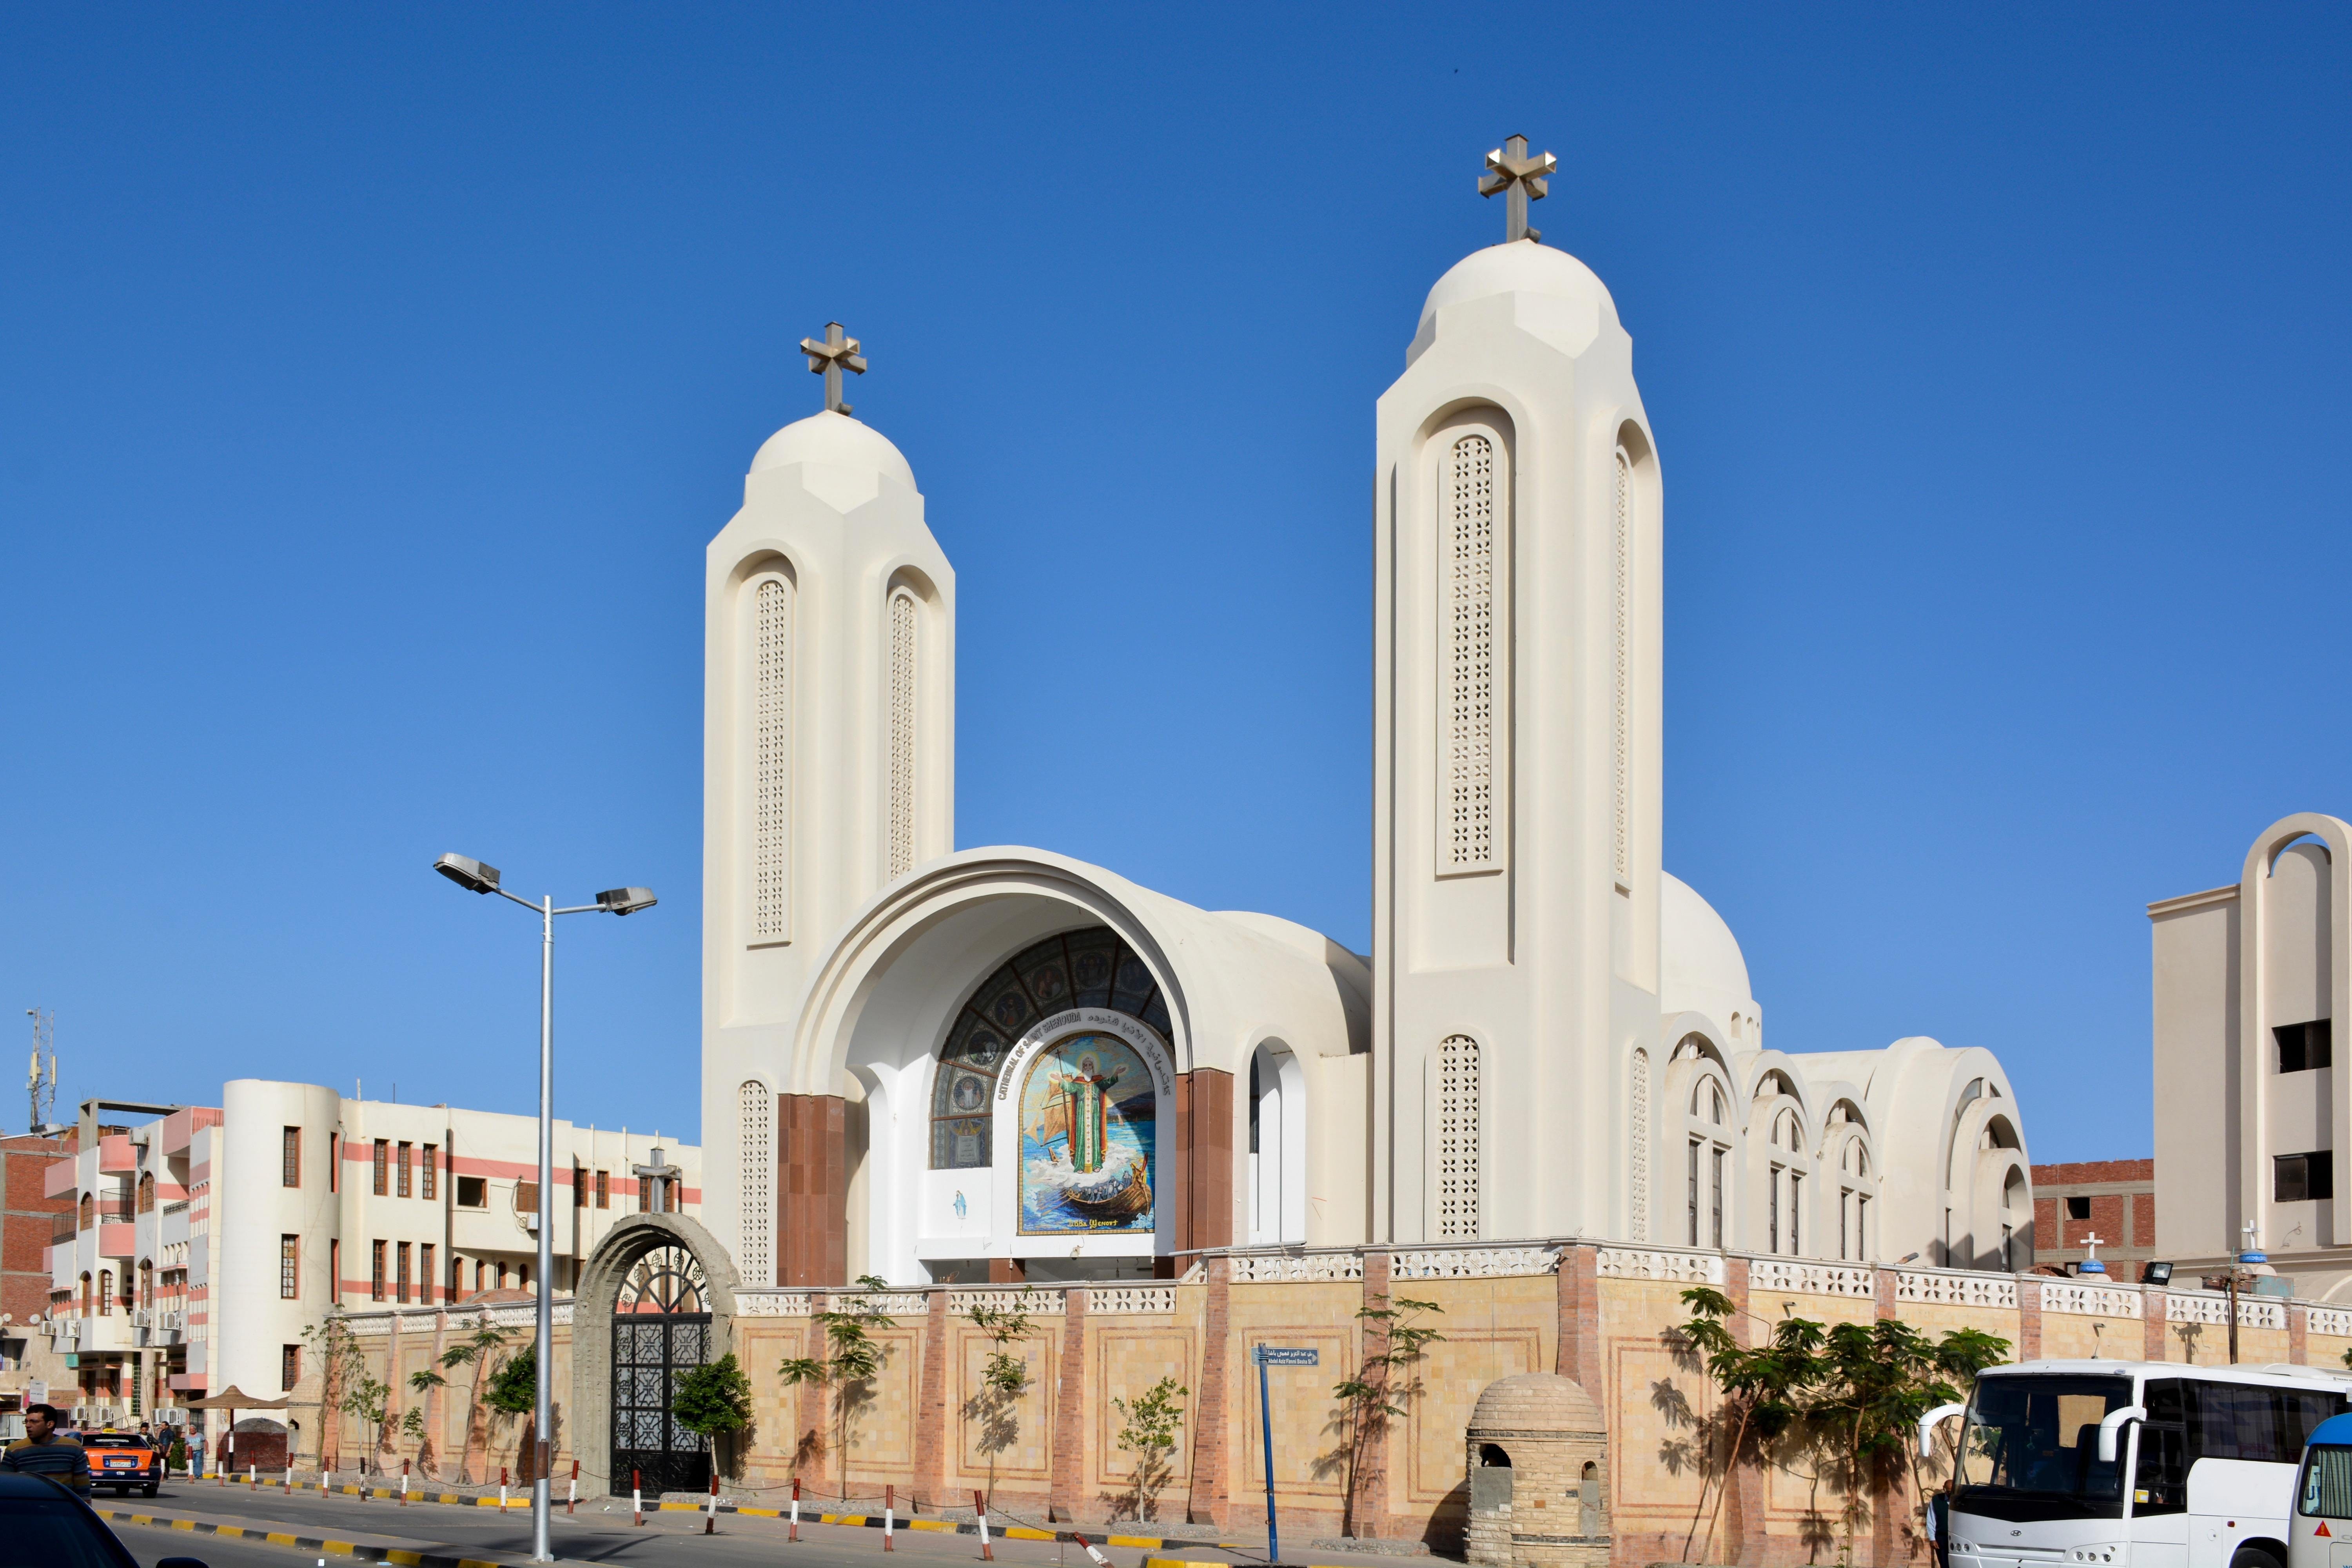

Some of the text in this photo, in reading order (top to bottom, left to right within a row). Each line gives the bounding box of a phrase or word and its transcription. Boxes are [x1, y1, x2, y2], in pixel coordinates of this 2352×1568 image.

[998, 1011, 1081, 1100] CATHEDRAL OF SAINT SHENOUDA
